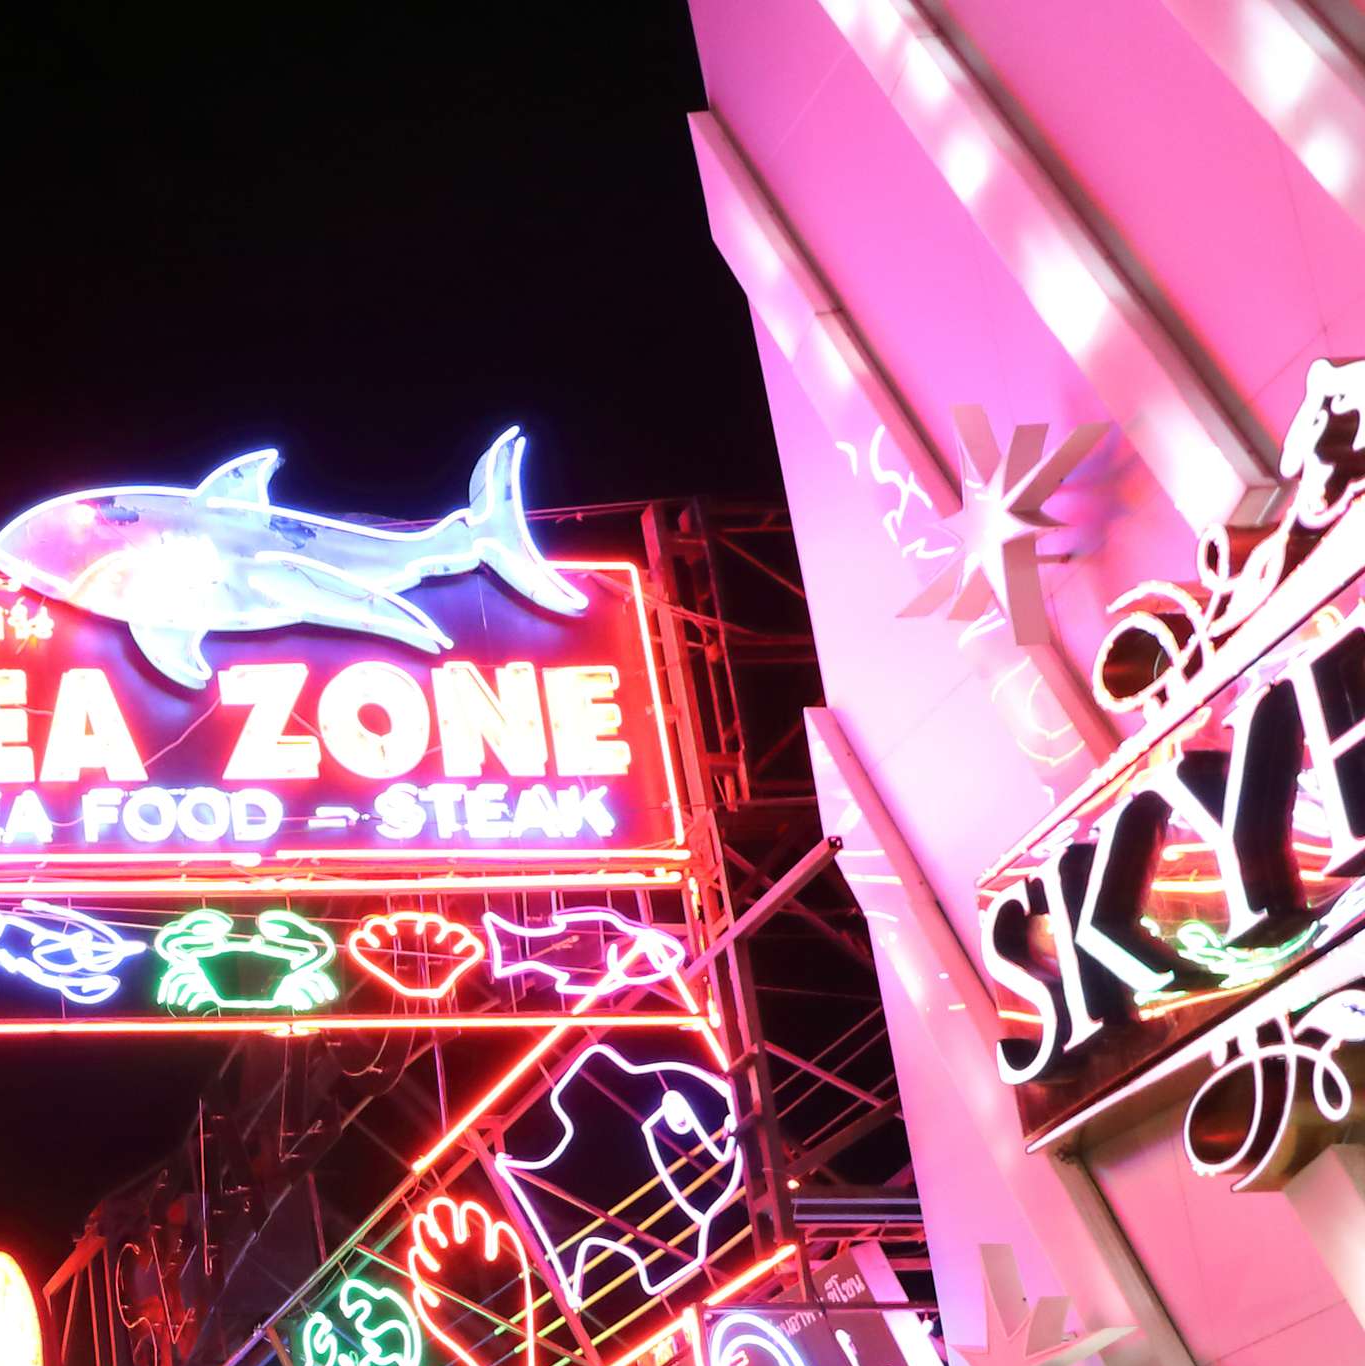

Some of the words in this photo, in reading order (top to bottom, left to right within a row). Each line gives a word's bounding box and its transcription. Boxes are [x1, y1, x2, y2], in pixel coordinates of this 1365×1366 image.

[220, 660, 631, 782] ZONE
[83, 786, 284, 845] FOOD
[372, 782, 618, 841] STEAK
